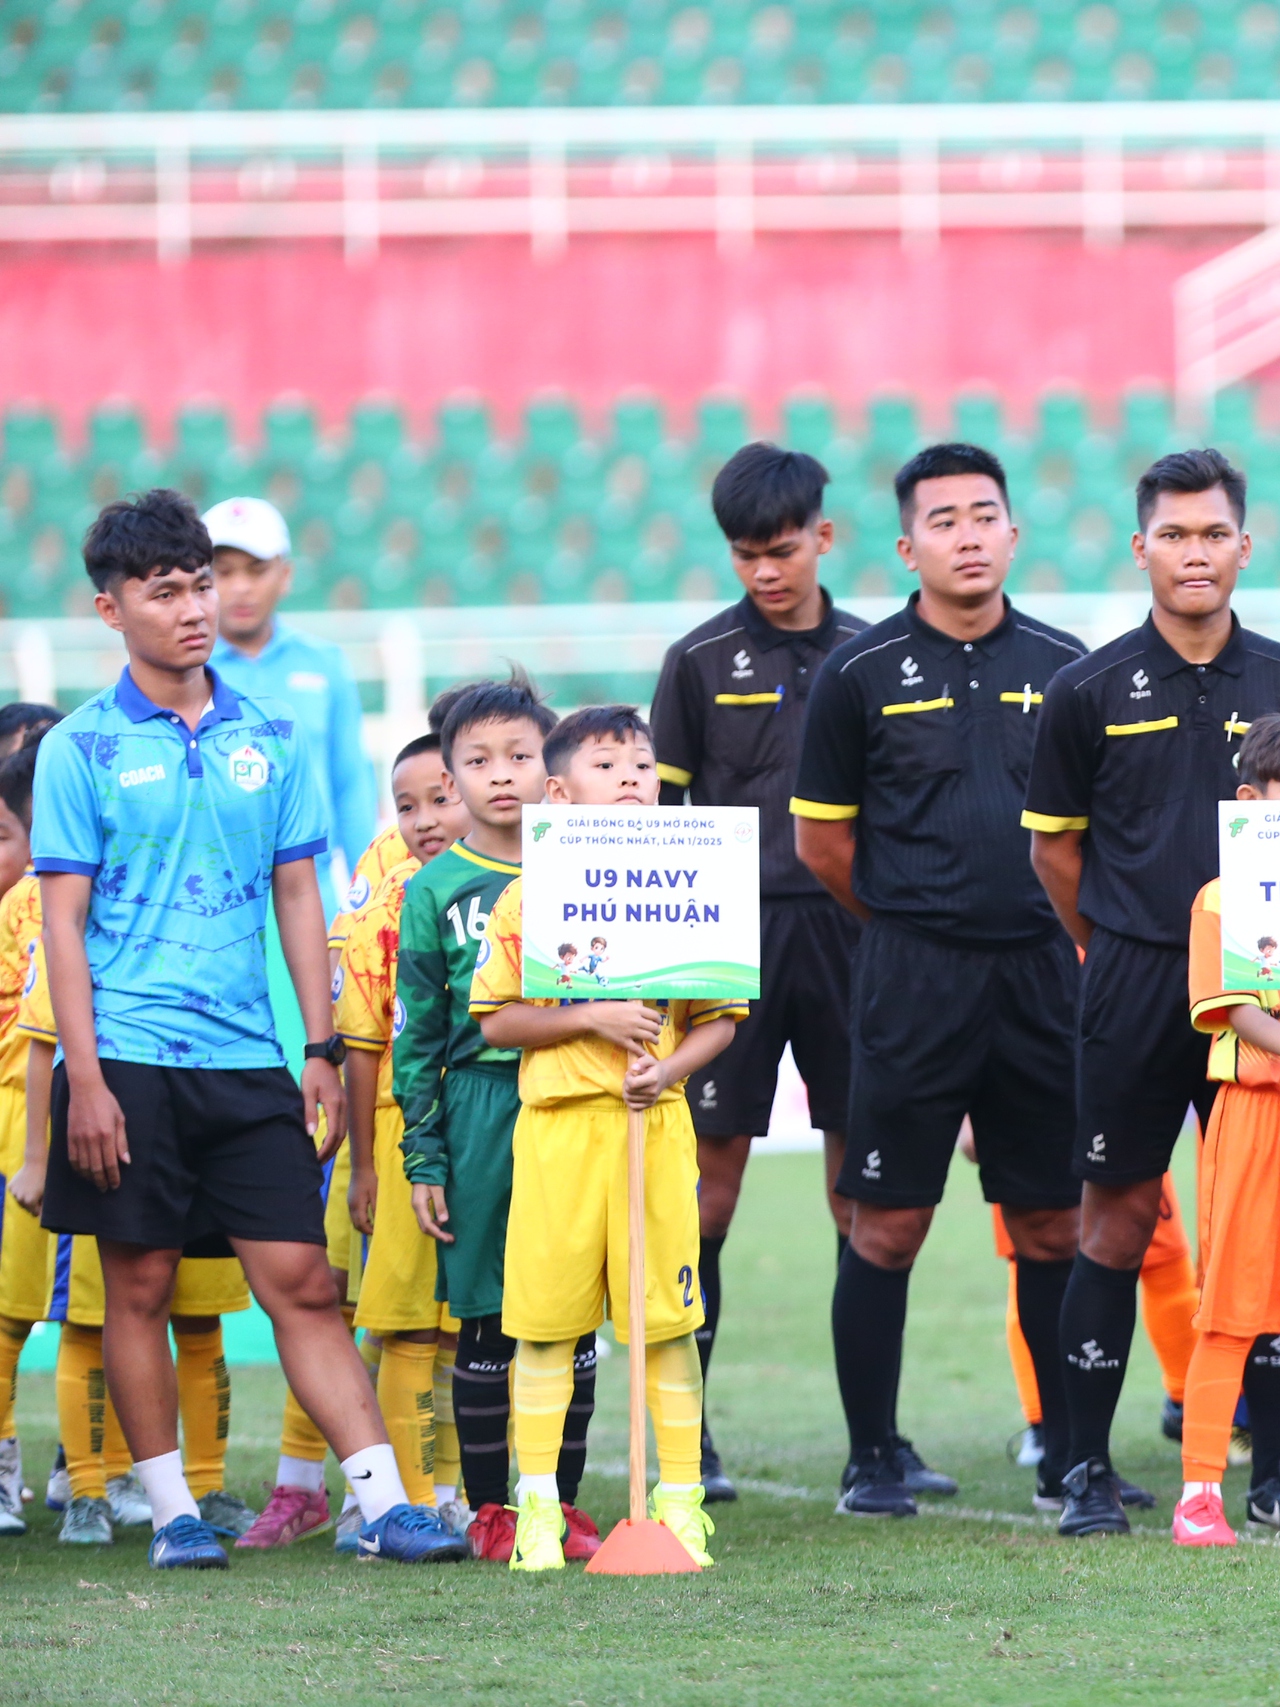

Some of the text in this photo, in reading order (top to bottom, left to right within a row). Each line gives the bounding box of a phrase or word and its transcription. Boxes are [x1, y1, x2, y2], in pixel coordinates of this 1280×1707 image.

[1130, 689, 1151, 699] egan
[119, 764, 166, 788] COACH
[593, 815, 625, 828] BÓNG
[646, 819, 661, 828] U9
[559, 833, 582, 845] CÚP
[688, 836, 723, 846] 1/2025
[1257, 828, 1280, 840] CÚP
[585, 868, 699, 888] U9 NAVY
[447, 896, 490, 946] 16
[563, 898, 720, 928] PHÚ NHUẬN
[678, 1264, 694, 1308] 2
[1067, 1353, 1119, 1371] egan
